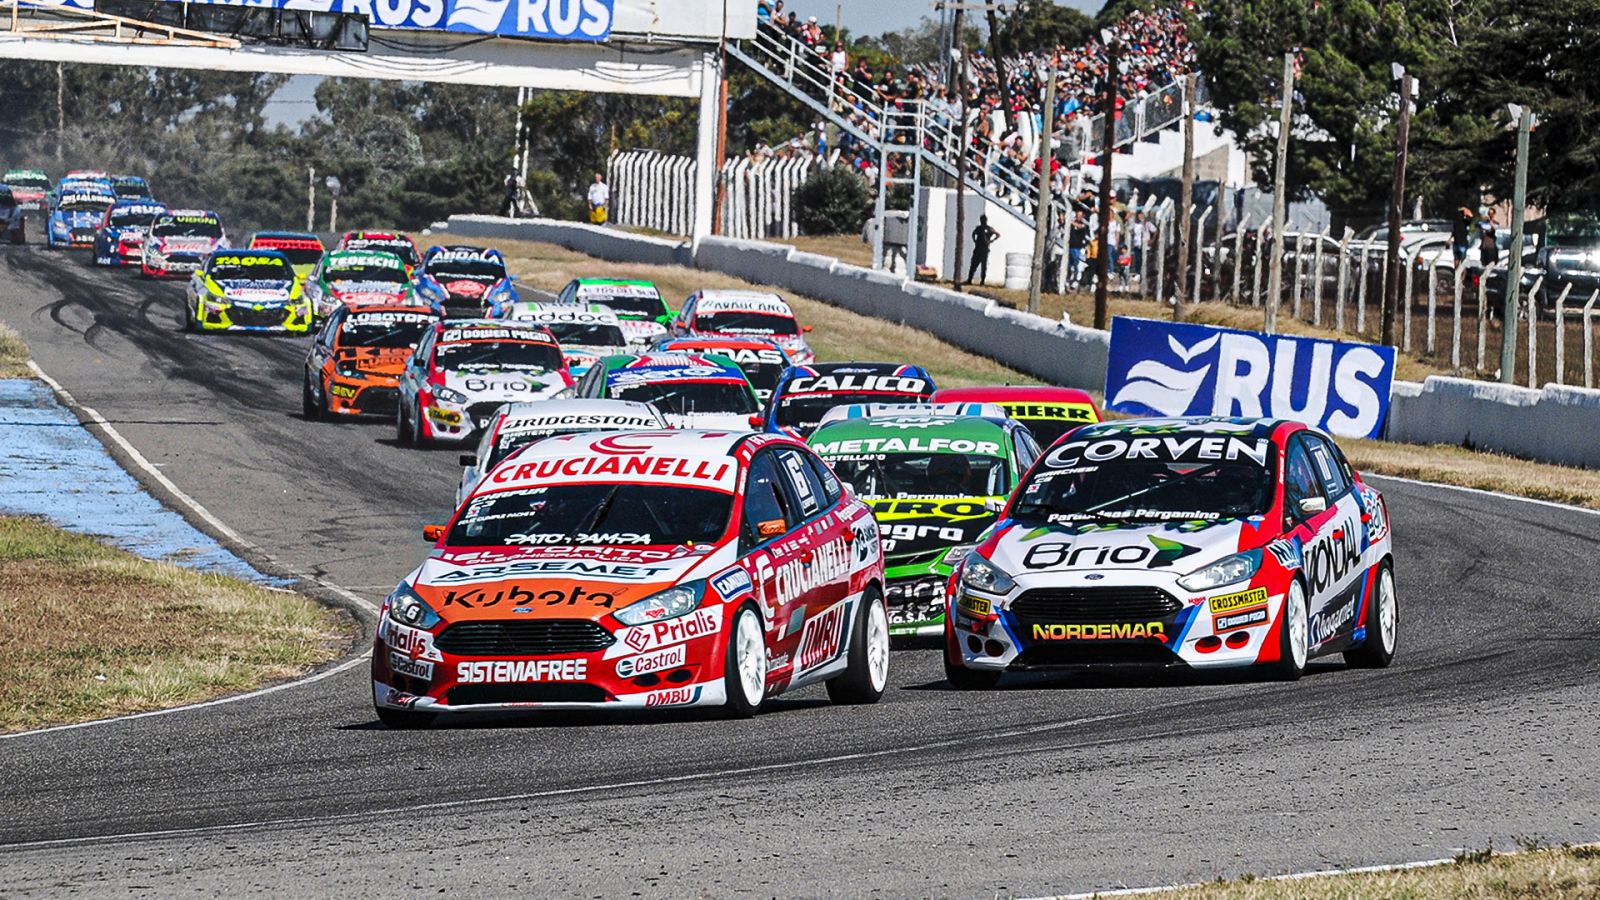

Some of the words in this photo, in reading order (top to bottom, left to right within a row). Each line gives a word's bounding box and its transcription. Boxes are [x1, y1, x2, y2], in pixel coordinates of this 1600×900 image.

[788, 376, 925, 393] CALICO
[1212, 332, 1385, 438] RUS
[504, 415, 656, 429] BRIDGESTONE
[812, 437, 1000, 454] METALFOR
[1044, 437, 1268, 467] CORVEN
[493, 456, 730, 483] CRUCIANELLI
[1135, 508, 1220, 522] Pergamino
[1022, 542, 1149, 569] Brio
[438, 561, 672, 580] ARSEMET
[443, 586, 617, 608] Kubota
[1211, 589, 1267, 610] CROSSMASTER
[653, 612, 717, 644] Prialis
[1032, 621, 1166, 641] NORDEMAQ
[456, 659, 588, 683] SISTEMAFREE
[635, 651, 682, 673] Castrol
